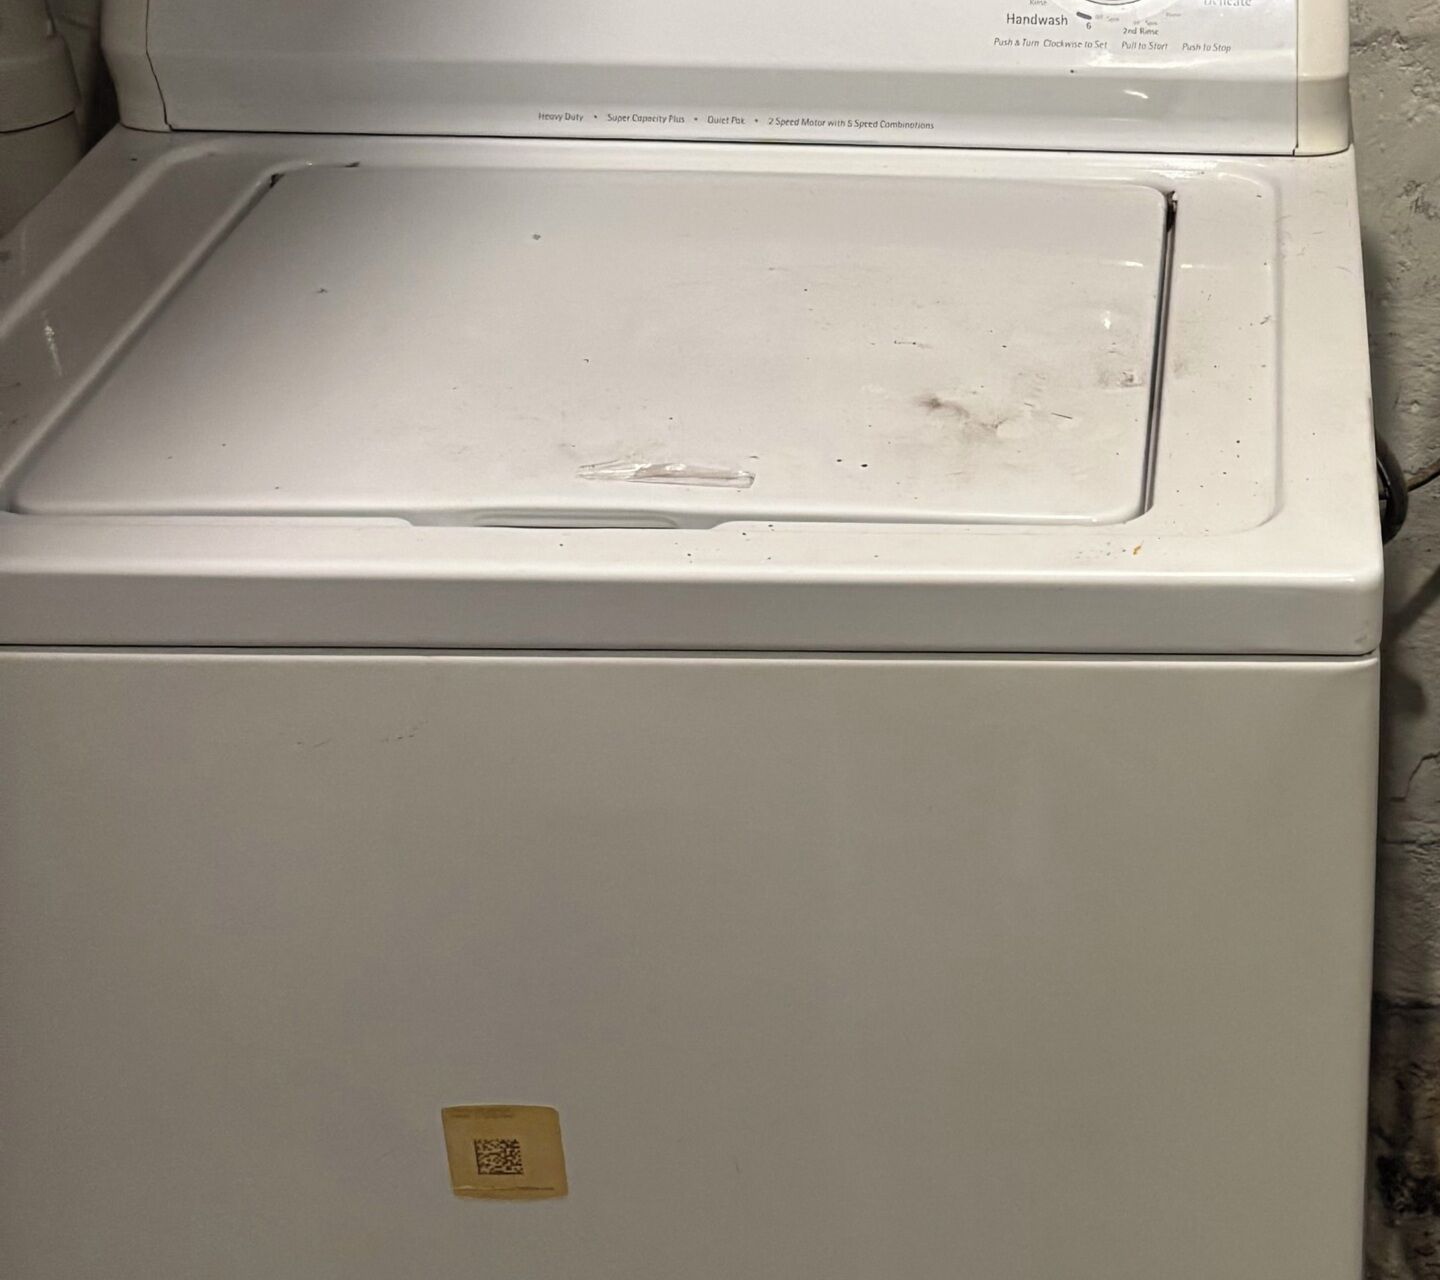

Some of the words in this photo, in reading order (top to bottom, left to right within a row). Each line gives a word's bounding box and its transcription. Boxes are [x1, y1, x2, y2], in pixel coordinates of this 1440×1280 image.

[1006, 12, 1069, 26] Handwash
[993, 37, 1013, 47] Push
[1022, 38, 1040, 48] Turn
[1043, 38, 1083, 49] Clockwise
[1084, 40, 1093, 49] to
[1094, 40, 1108, 49] Set
[1121, 41, 1138, 50] Pull
[1139, 42, 1147, 50] to
[1148, 42, 1168, 51] Start
[1182, 42, 1201, 52] Push
[1202, 43, 1211, 52] to
[1213, 44, 1232, 53] Stop
[538, 112, 563, 123] Heavy
[564, 112, 584, 122] Duty
[607, 113, 630, 124] Super
[632, 113, 667, 125] Capacity
[668, 115, 685, 124] Plus
[707, 115, 729, 125] Quiet
[775, 117, 800, 128] Speed
[801, 118, 826, 127] Motor
[827, 118, 846, 128] with
[854, 119, 878, 130] Speed
[880, 119, 935, 130] Combinations
